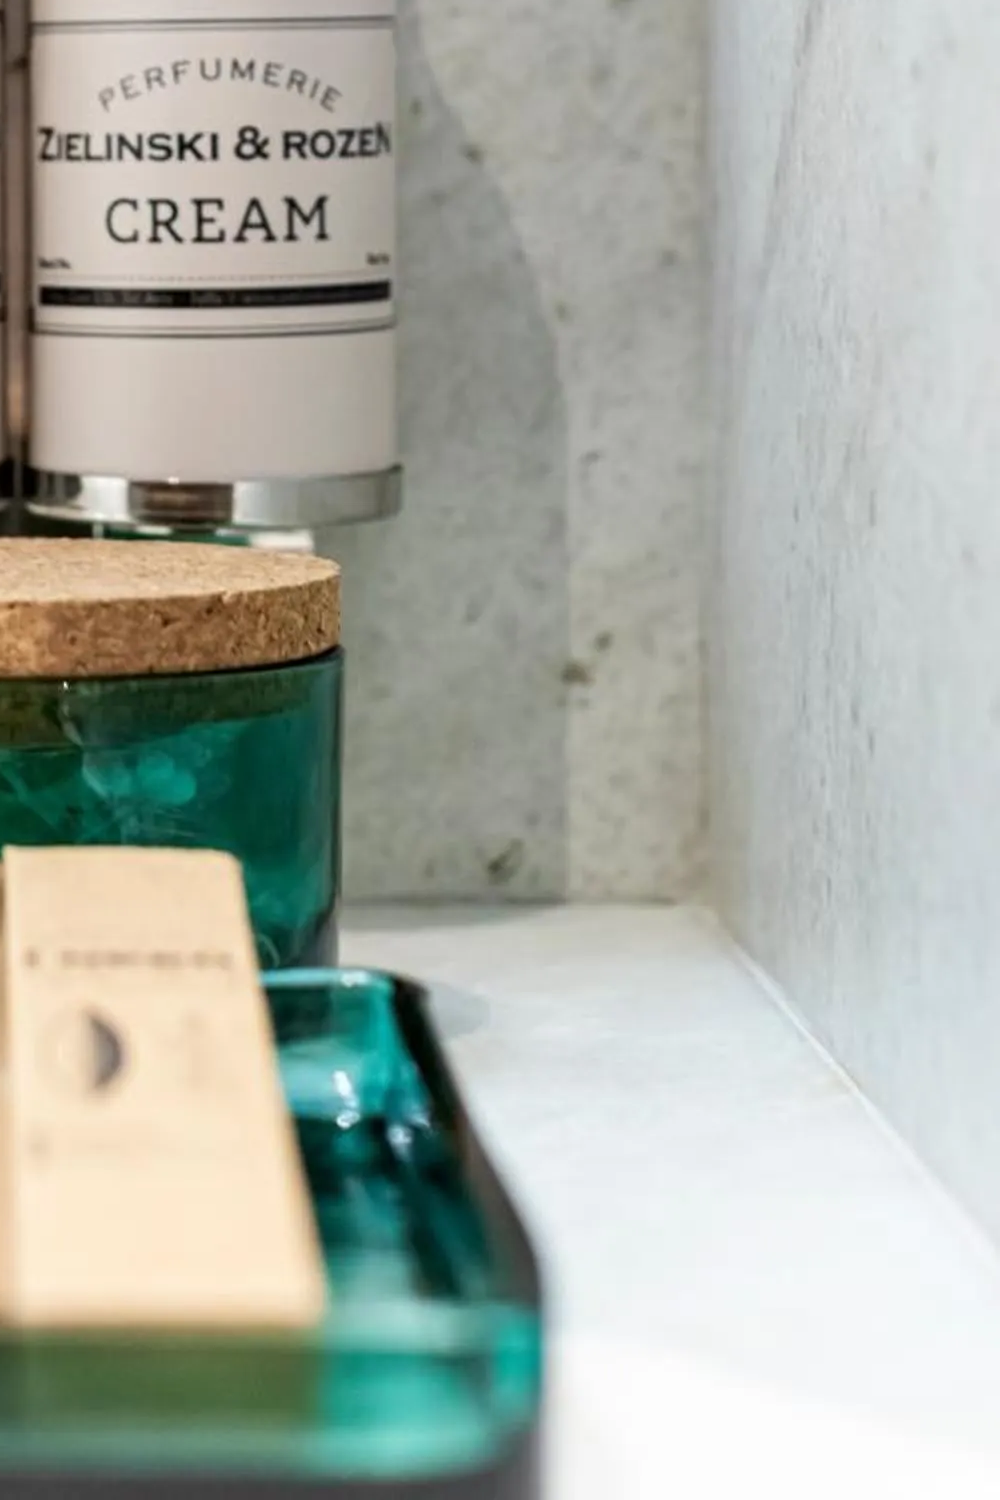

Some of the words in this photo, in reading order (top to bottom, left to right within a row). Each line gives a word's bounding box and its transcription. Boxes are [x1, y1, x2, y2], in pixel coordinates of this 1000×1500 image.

[98, 58, 343, 113] PERFUMERIE
[38, 126, 219, 162] ZIELINSKI
[234, 126, 270, 162] &
[282, 121, 392, 160] ROZEN
[105, 195, 330, 244] CREAM
